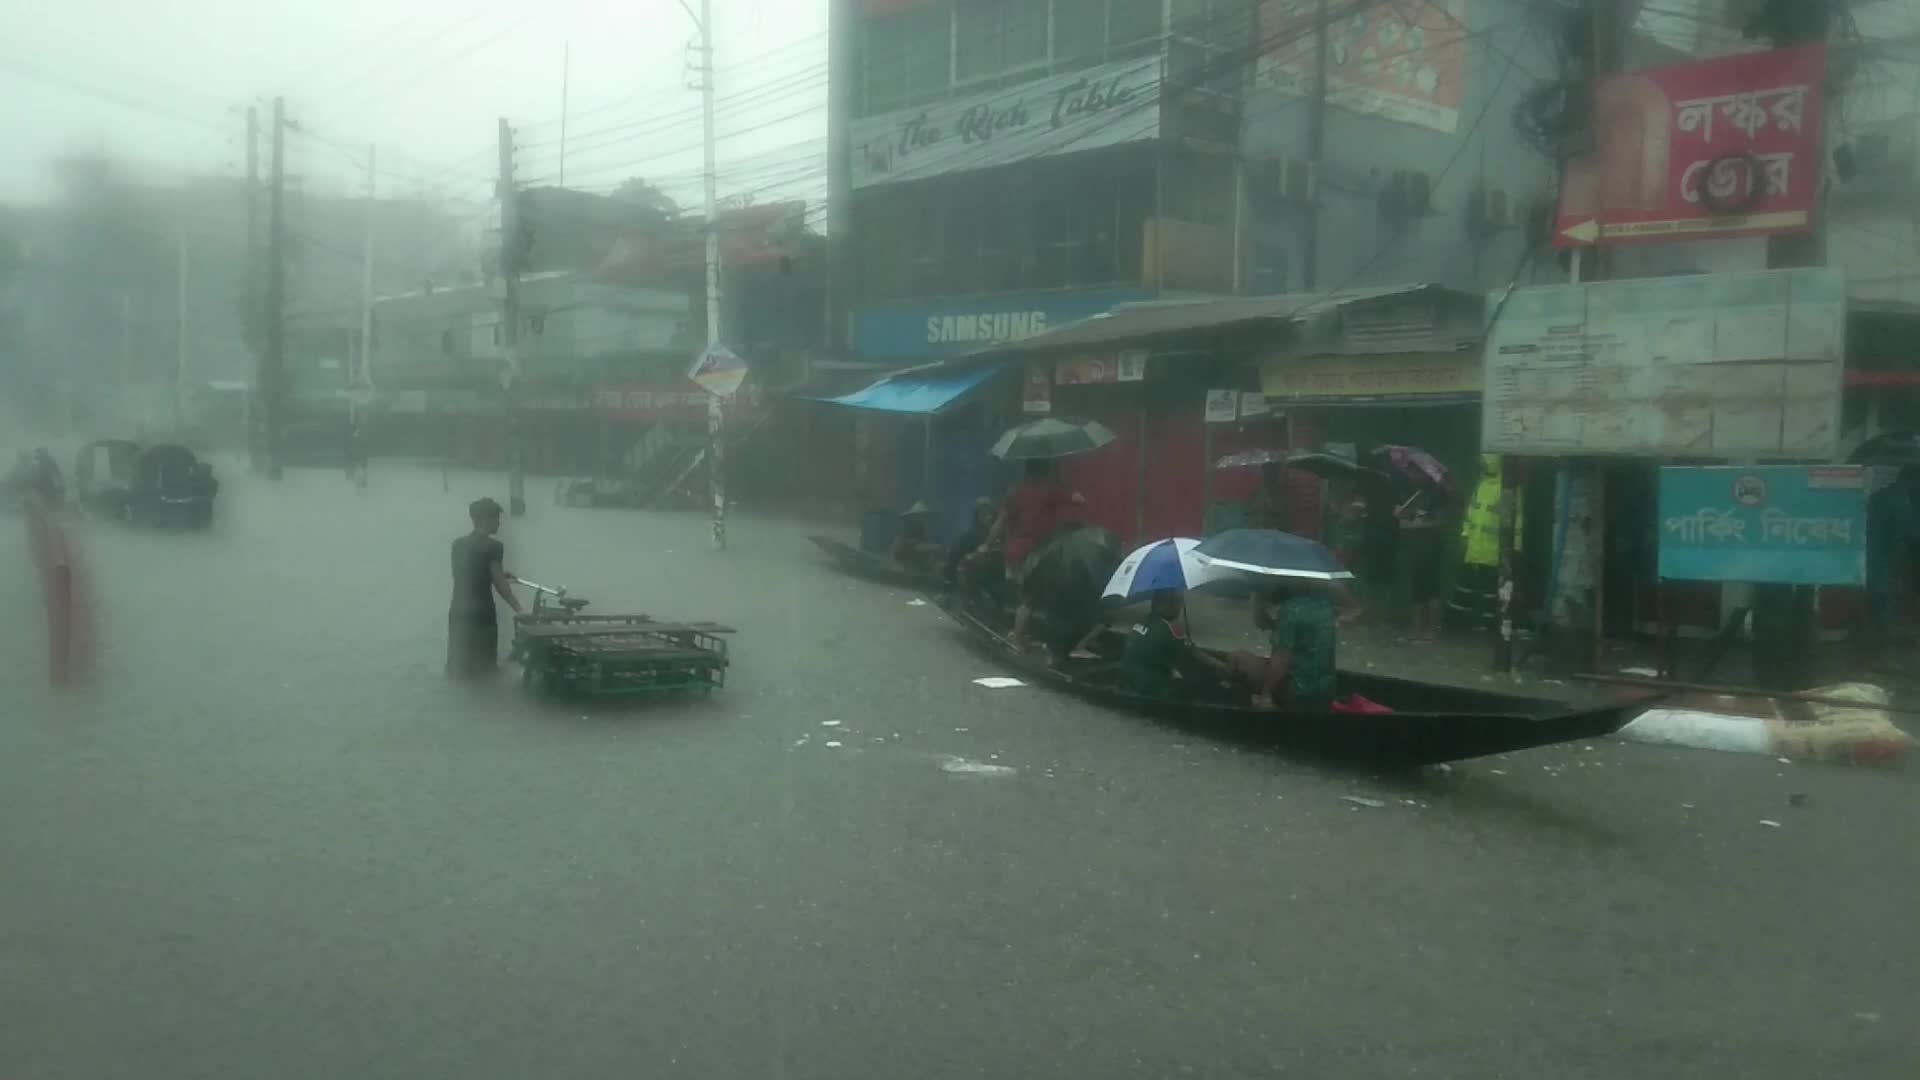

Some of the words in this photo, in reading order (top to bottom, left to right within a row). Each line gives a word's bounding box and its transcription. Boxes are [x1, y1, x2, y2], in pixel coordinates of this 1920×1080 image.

[894, 109, 943, 156] The
[956, 97, 1030, 144] Rich
[1048, 76, 1138, 128] Table
[927, 310, 1047, 344] SAMSUNG
